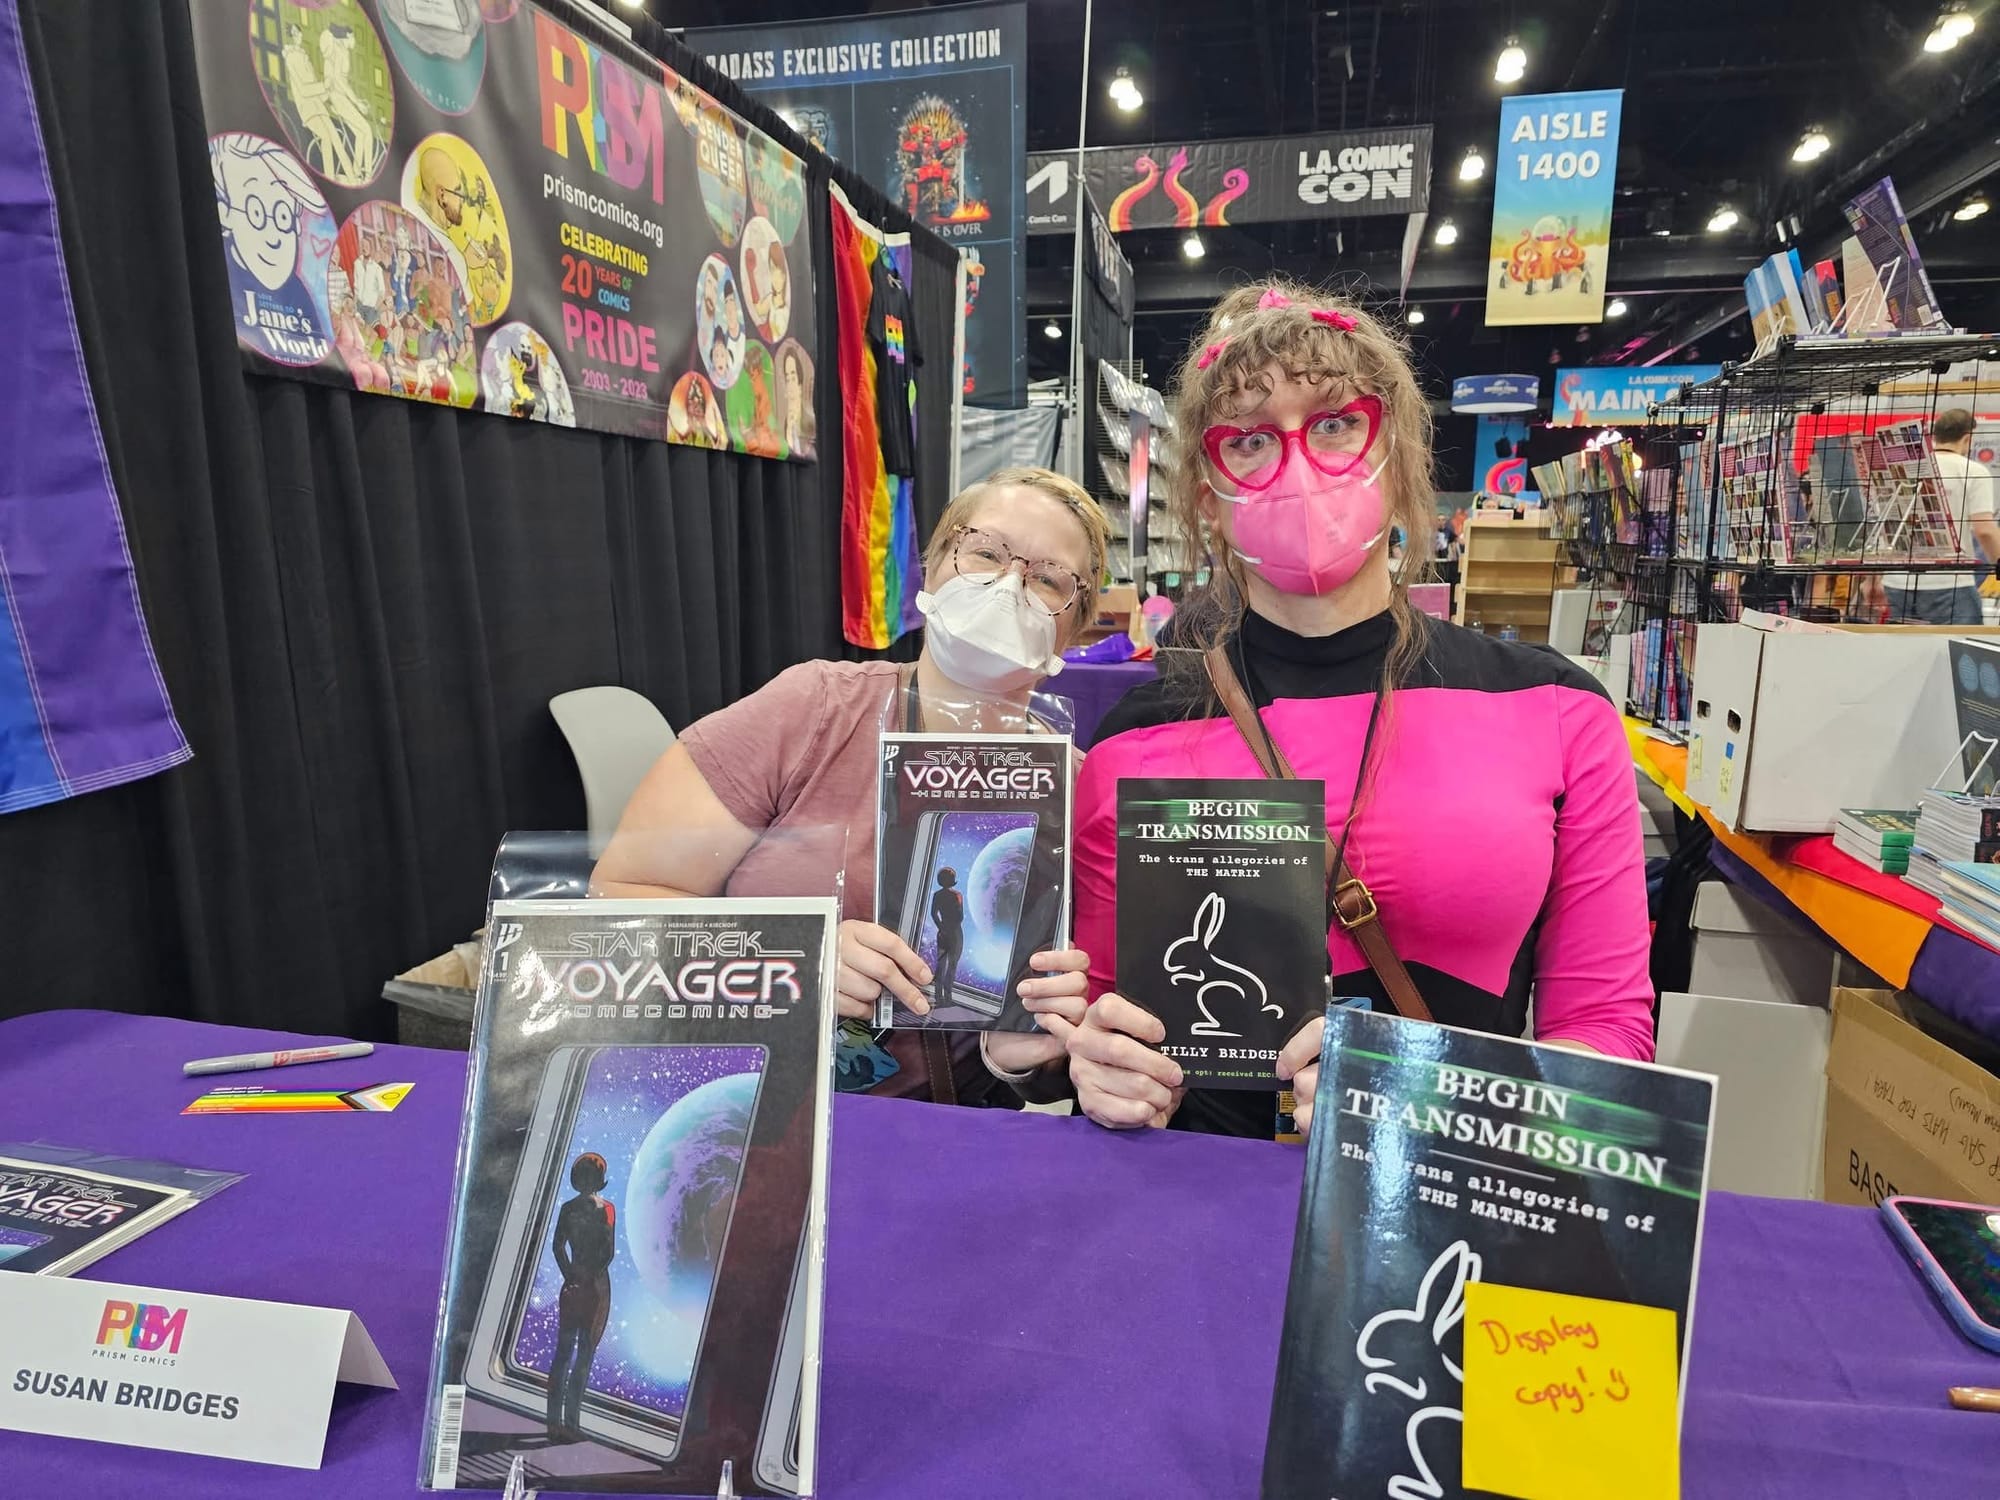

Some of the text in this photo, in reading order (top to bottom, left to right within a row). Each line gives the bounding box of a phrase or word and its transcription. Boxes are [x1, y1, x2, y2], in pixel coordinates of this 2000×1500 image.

[783, 42, 882, 76] EXCLUSIVE
[890, 28, 1001, 68] COLLECTION
[1511, 110, 1608, 143] AISLE
[700, 139, 745, 188] QUEER
[1338, 144, 1414, 171] COMIC
[1517, 151, 1600, 181] 1400
[1298, 169, 1412, 204] CON
[543, 172, 664, 248] prismcomics.org
[953, 222, 982, 236] OVER
[560, 222, 648, 277] CELEBRATING
[561, 254, 633, 299] 20 YEARS OF
[243, 290, 312, 334] Jane's
[598, 288, 630, 312] COMICS
[261, 325, 329, 358] World
[562, 302, 660, 373] PRIDE
[581, 368, 610, 392] 2003
[620, 378, 648, 400] 2023
[1568, 389, 1655, 411] MAIN
[904, 751, 1056, 767] STAR TREK
[904, 765, 1055, 792] VOYAGER
[911, 790, 1049, 800] HOMECOMING
[1187, 801, 1260, 817] BEGIN
[1137, 823, 1310, 841] TRANSMISSION
[1138, 854, 1308, 867] The trans allegories of
[1186, 868, 1261, 878] THE MATRIX
[537, 930, 806, 957] STAR TREK
[501, 952, 509, 971] 1
[550, 1004, 789, 1019] OMECOMING
[1160, 1045, 1281, 1060] TILLY BRIDGE
[1437, 1067, 1571, 1121] BEGIN
[1897, 1096, 1917, 1120] FOR
[1340, 1087, 1667, 1188] TRANSMISSION
[52, 1181, 138, 1208] TREK
[1341, 1142, 1656, 1233] The rans allegories of
[1418, 1185, 1558, 1235] THE MATRIX
[95, 1299, 189, 1354] PRISM
[1478, 1316, 1600, 1356] Display
[91, 1349, 176, 1367] PRISM COMICS
[13, 1368, 240, 1421] SUSAN BRIDGES
[1515, 1365, 1596, 1413] copy!
